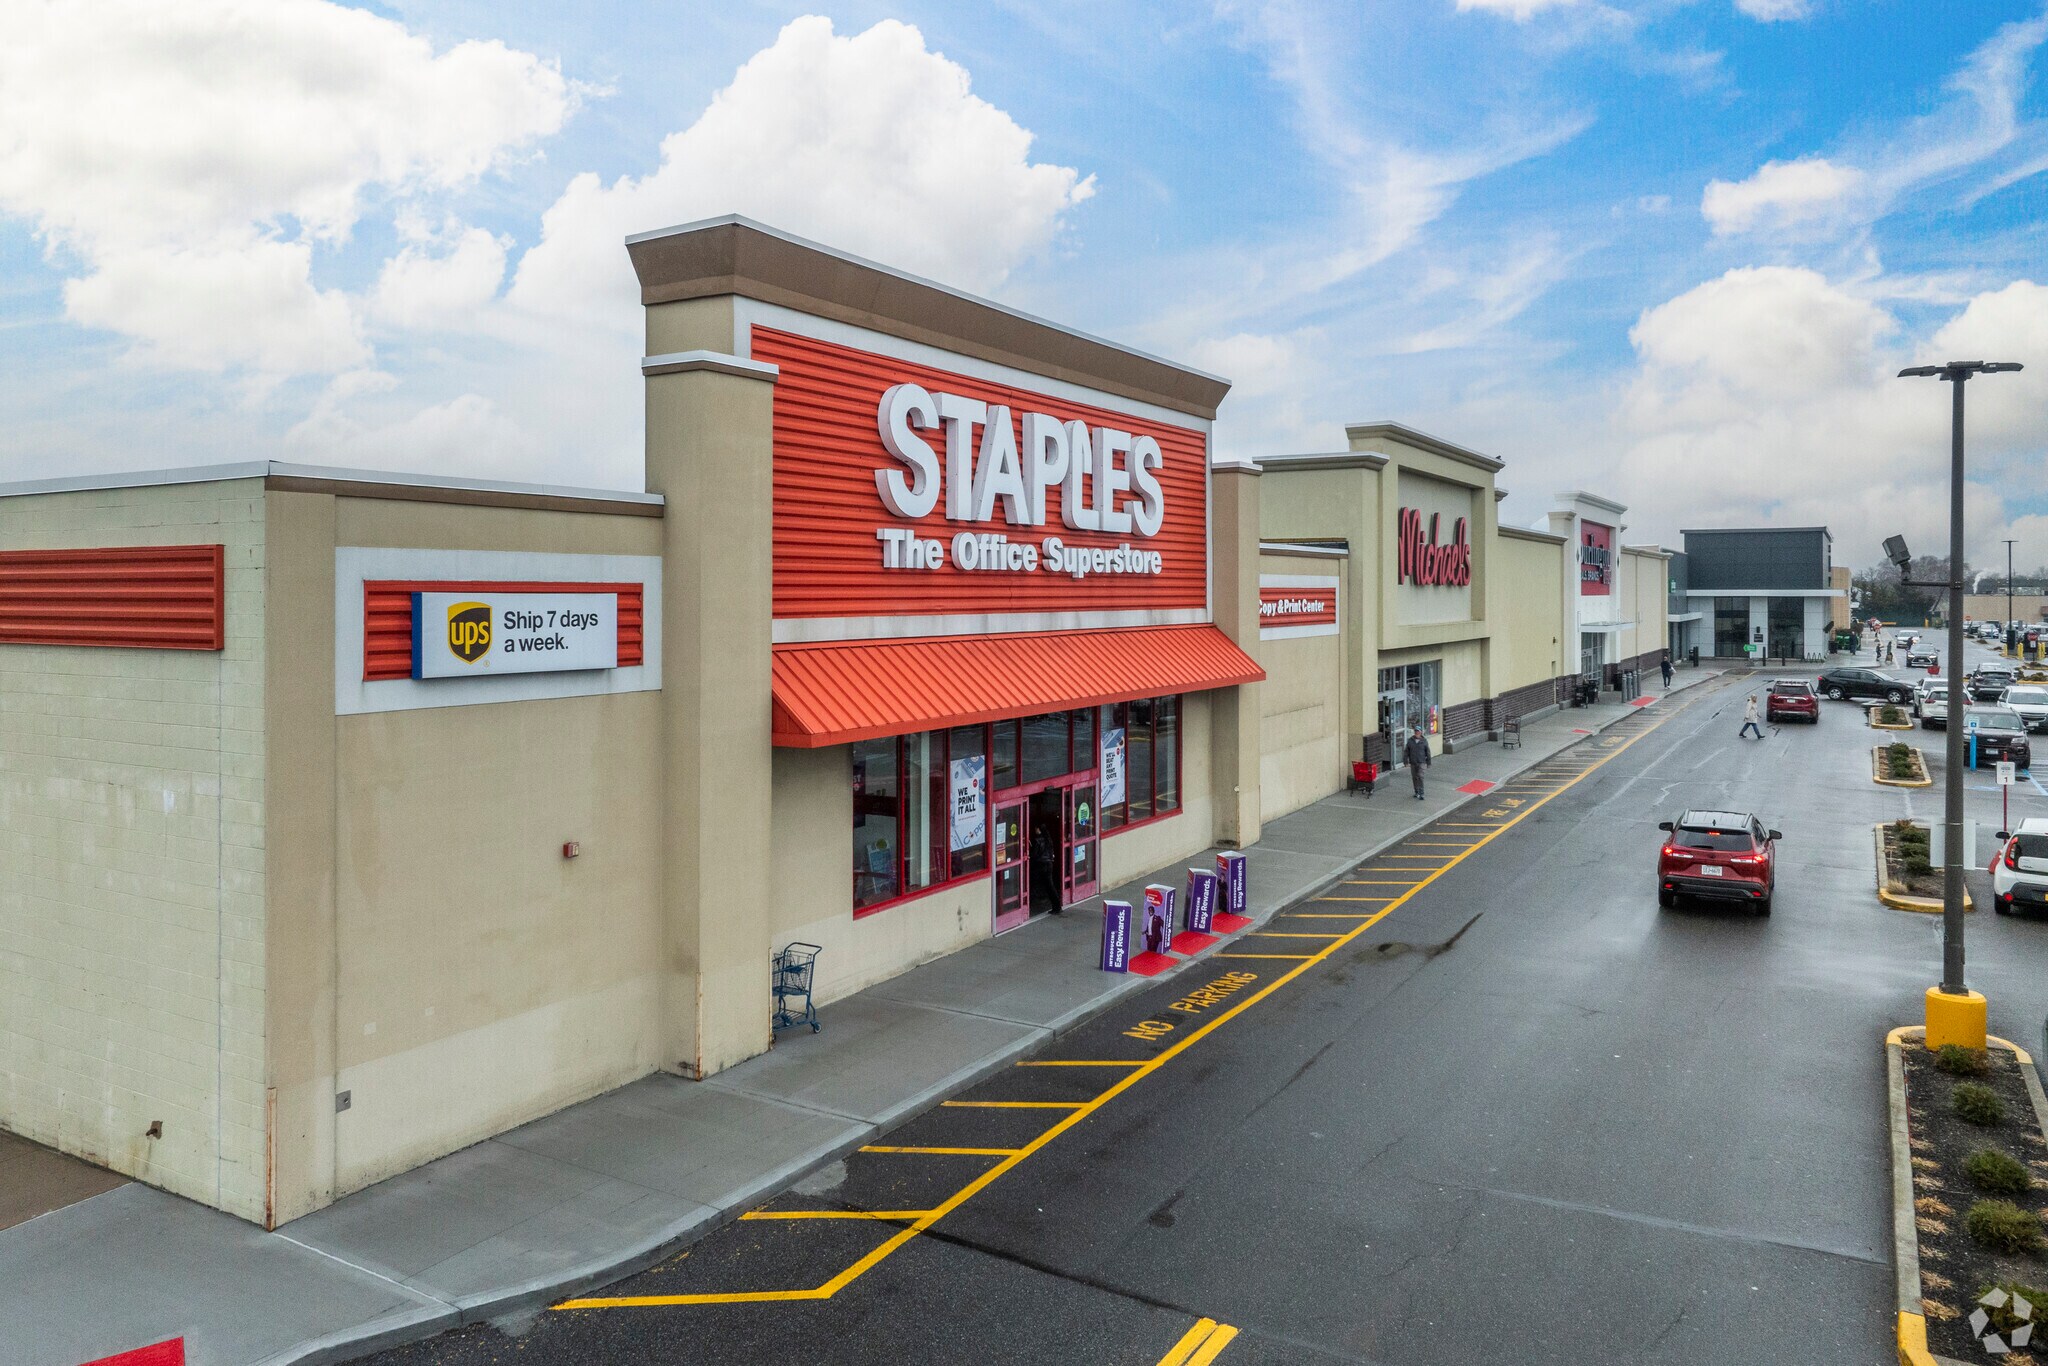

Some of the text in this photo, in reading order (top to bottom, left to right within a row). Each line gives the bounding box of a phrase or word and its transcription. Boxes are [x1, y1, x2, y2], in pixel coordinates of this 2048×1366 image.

[874, 383, 1164, 537] STAPLES
[877, 528, 1162, 578] The Office Superstore
[1284, 598, 1301, 613] Print
[1302, 598, 1325, 613] Center
[503, 609, 598, 633] Ship 7 days
[451, 621, 490, 655] ups
[504, 633, 569, 652] a week.
[957, 787, 968, 797] WE
[958, 794, 976, 806] PRINT
[958, 803, 976, 815] IT ALL
[1199, 878, 1211, 929] Easy Rewards.
[1114, 909, 1126, 968] Easy Rewards.
[1122, 971, 1258, 1041] NO PARKING
